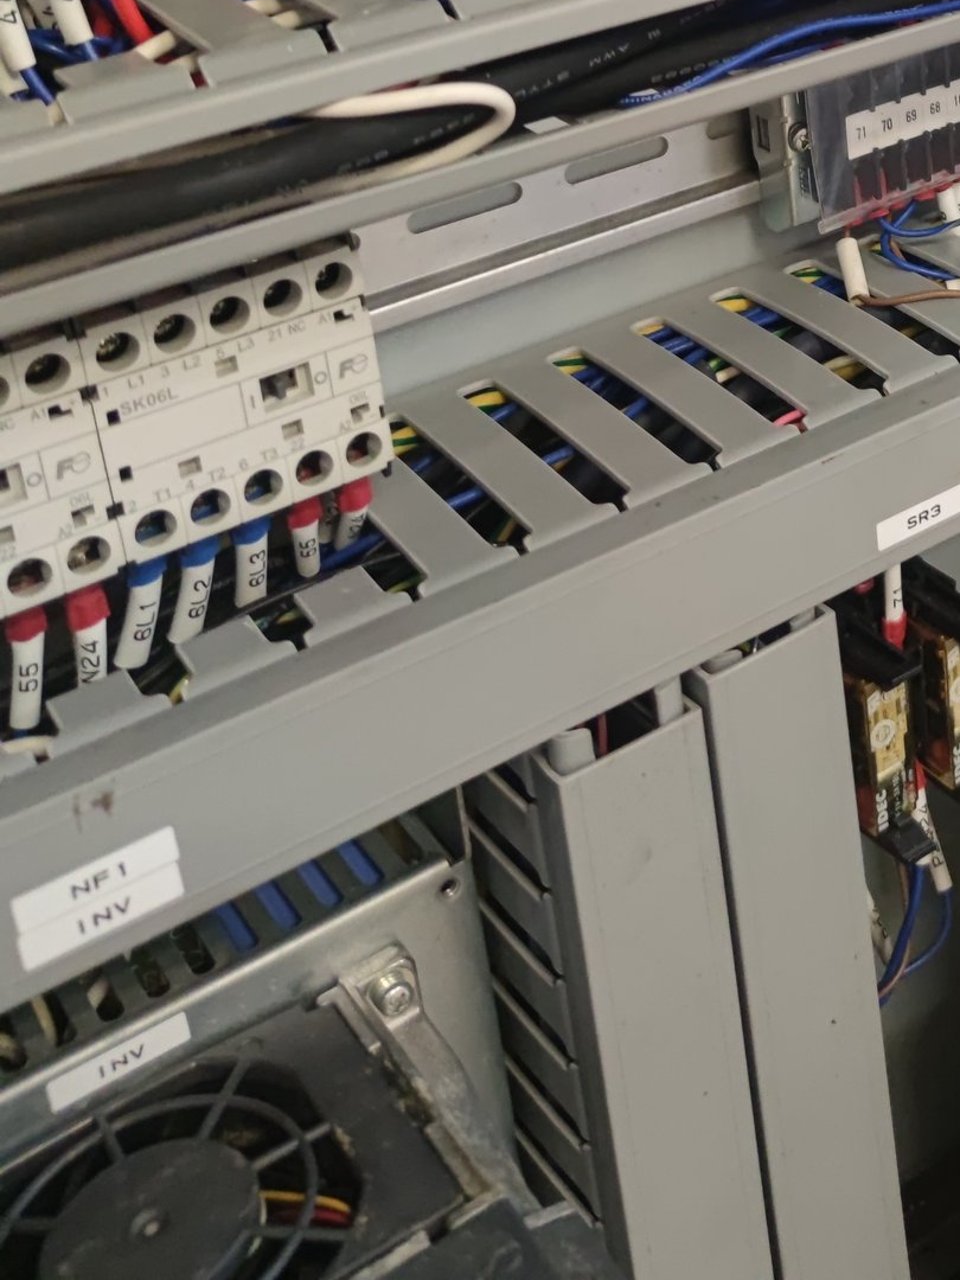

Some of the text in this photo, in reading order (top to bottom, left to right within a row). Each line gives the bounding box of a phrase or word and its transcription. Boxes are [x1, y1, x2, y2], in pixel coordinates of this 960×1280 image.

[856, 127, 868, 141] 71
[882, 118, 894, 133] 70
[906, 109, 918, 123] 69
[120, 387, 179, 417] SK06L
[905, 503, 943, 533] SR3
[19, 662, 39, 692] 55
[876, 788, 889, 833] IDEC
[69, 861, 128, 901] NF1
[77, 896, 131, 935] INV
[98, 1044, 146, 1079] INV
